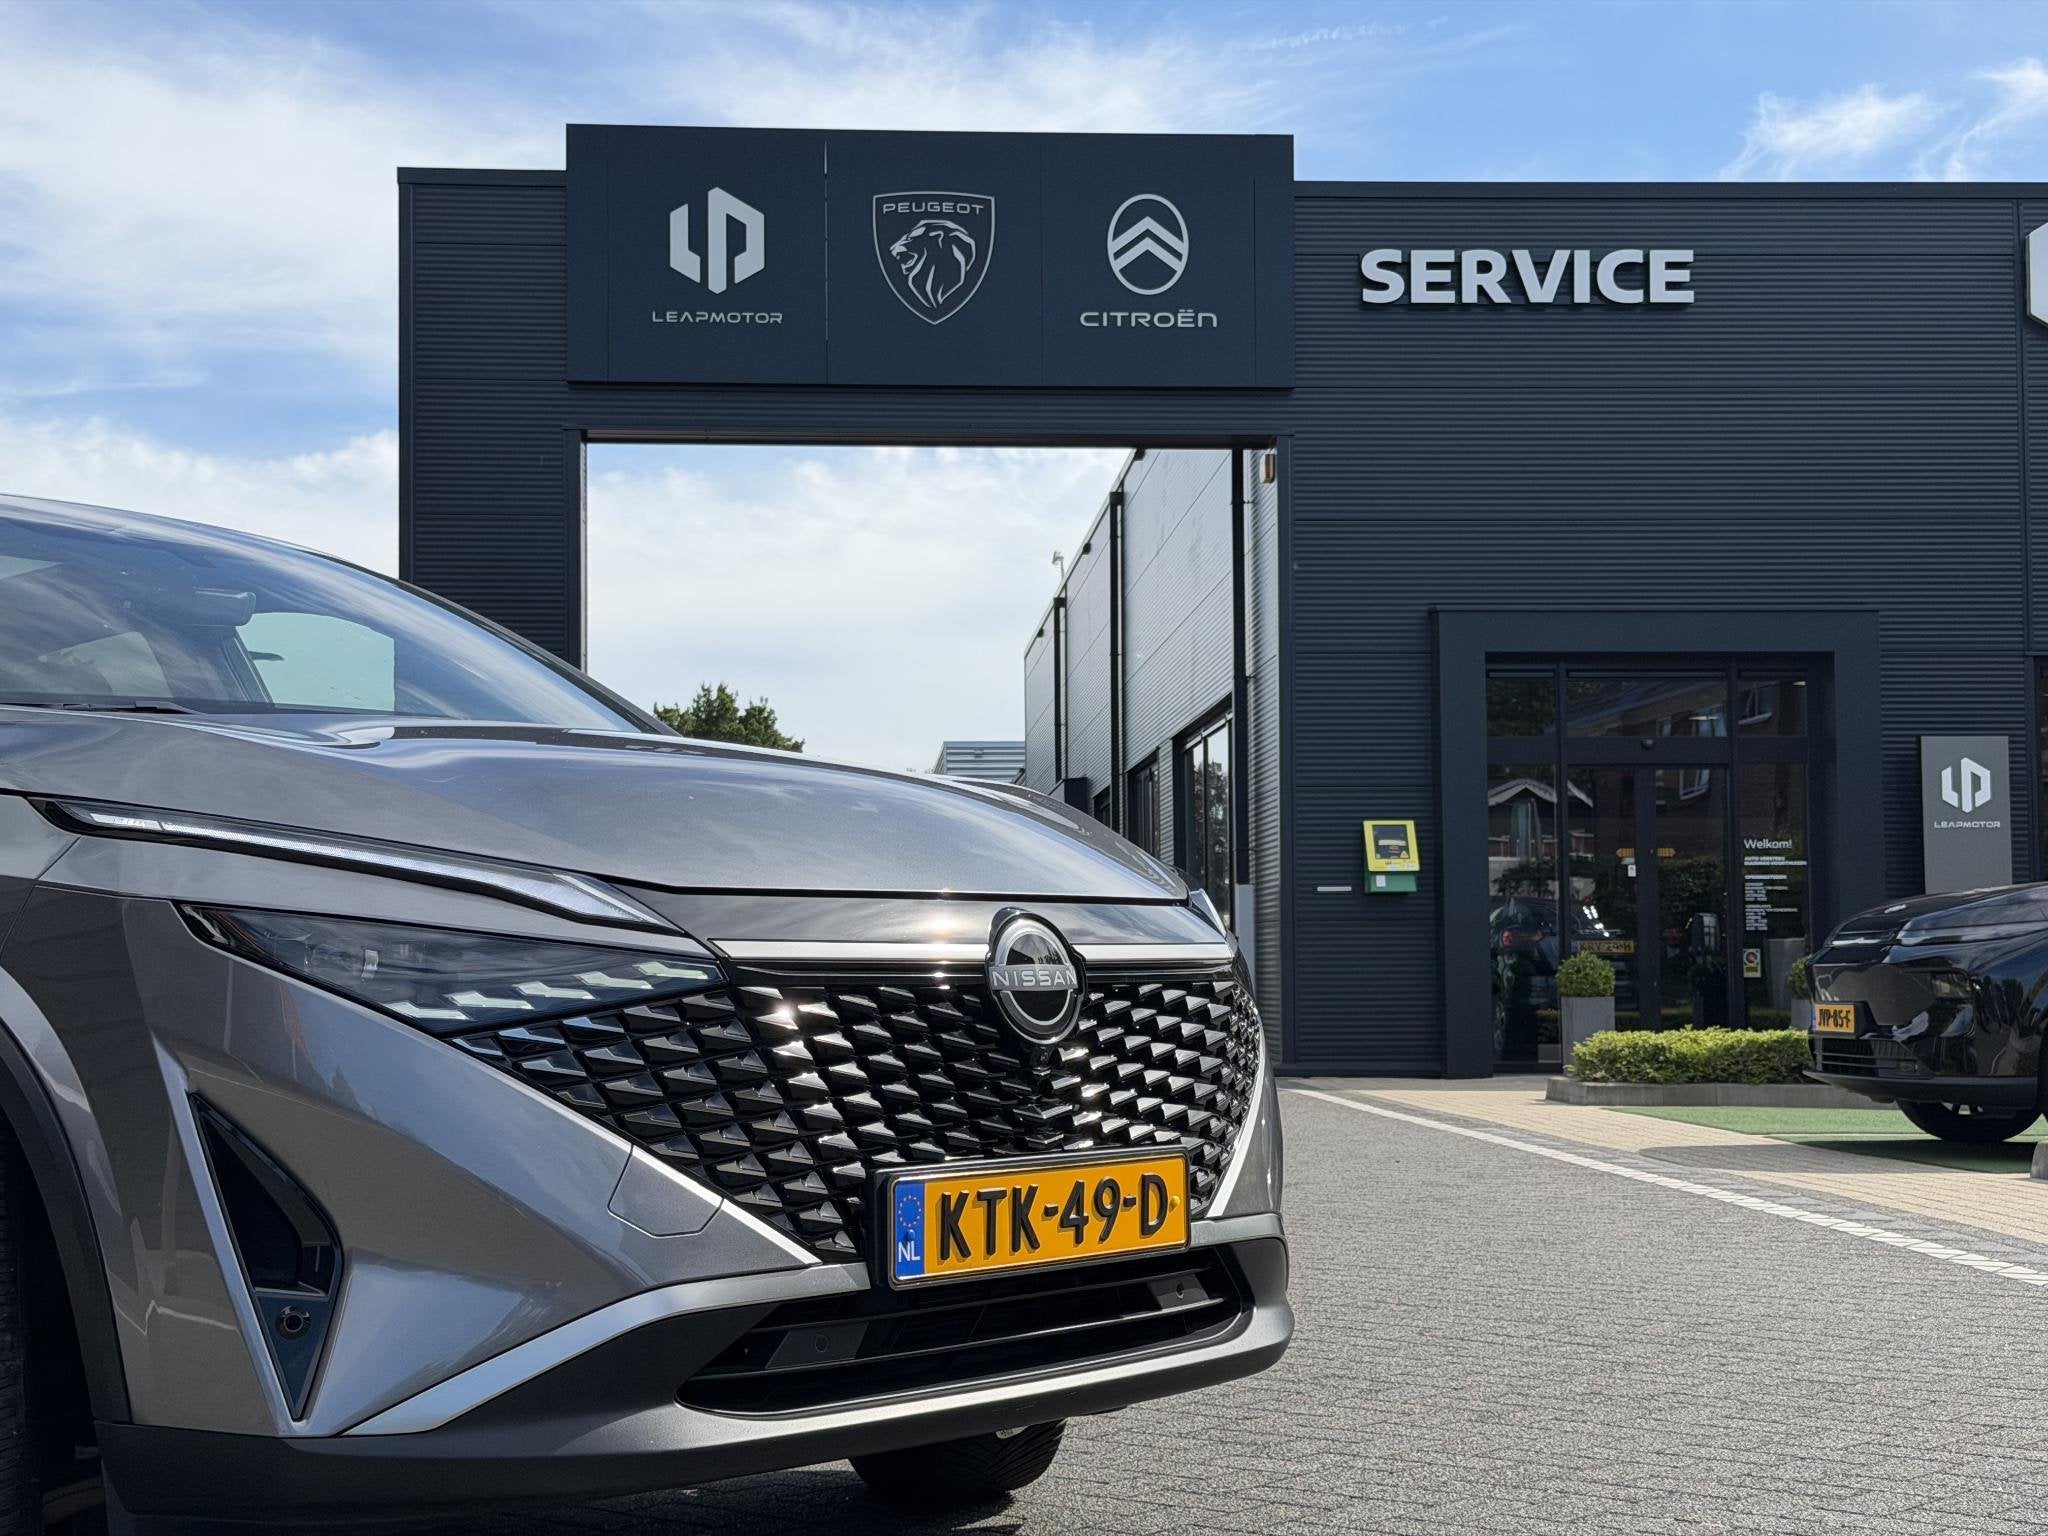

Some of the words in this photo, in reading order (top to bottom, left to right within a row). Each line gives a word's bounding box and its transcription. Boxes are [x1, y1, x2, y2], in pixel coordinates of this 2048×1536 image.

[882, 202, 985, 215] PEUGEOT
[1360, 248, 1696, 304] SERVICE
[652, 311, 784, 325] LEAPMOTOR
[1933, 820, 2001, 829] LEAPMOTOR
[1743, 838, 1793, 849] Welkom!
[991, 967, 1079, 988] NISSAN
[938, 1172, 1170, 1263] KTK-49-D
[897, 1241, 921, 1262] NL
